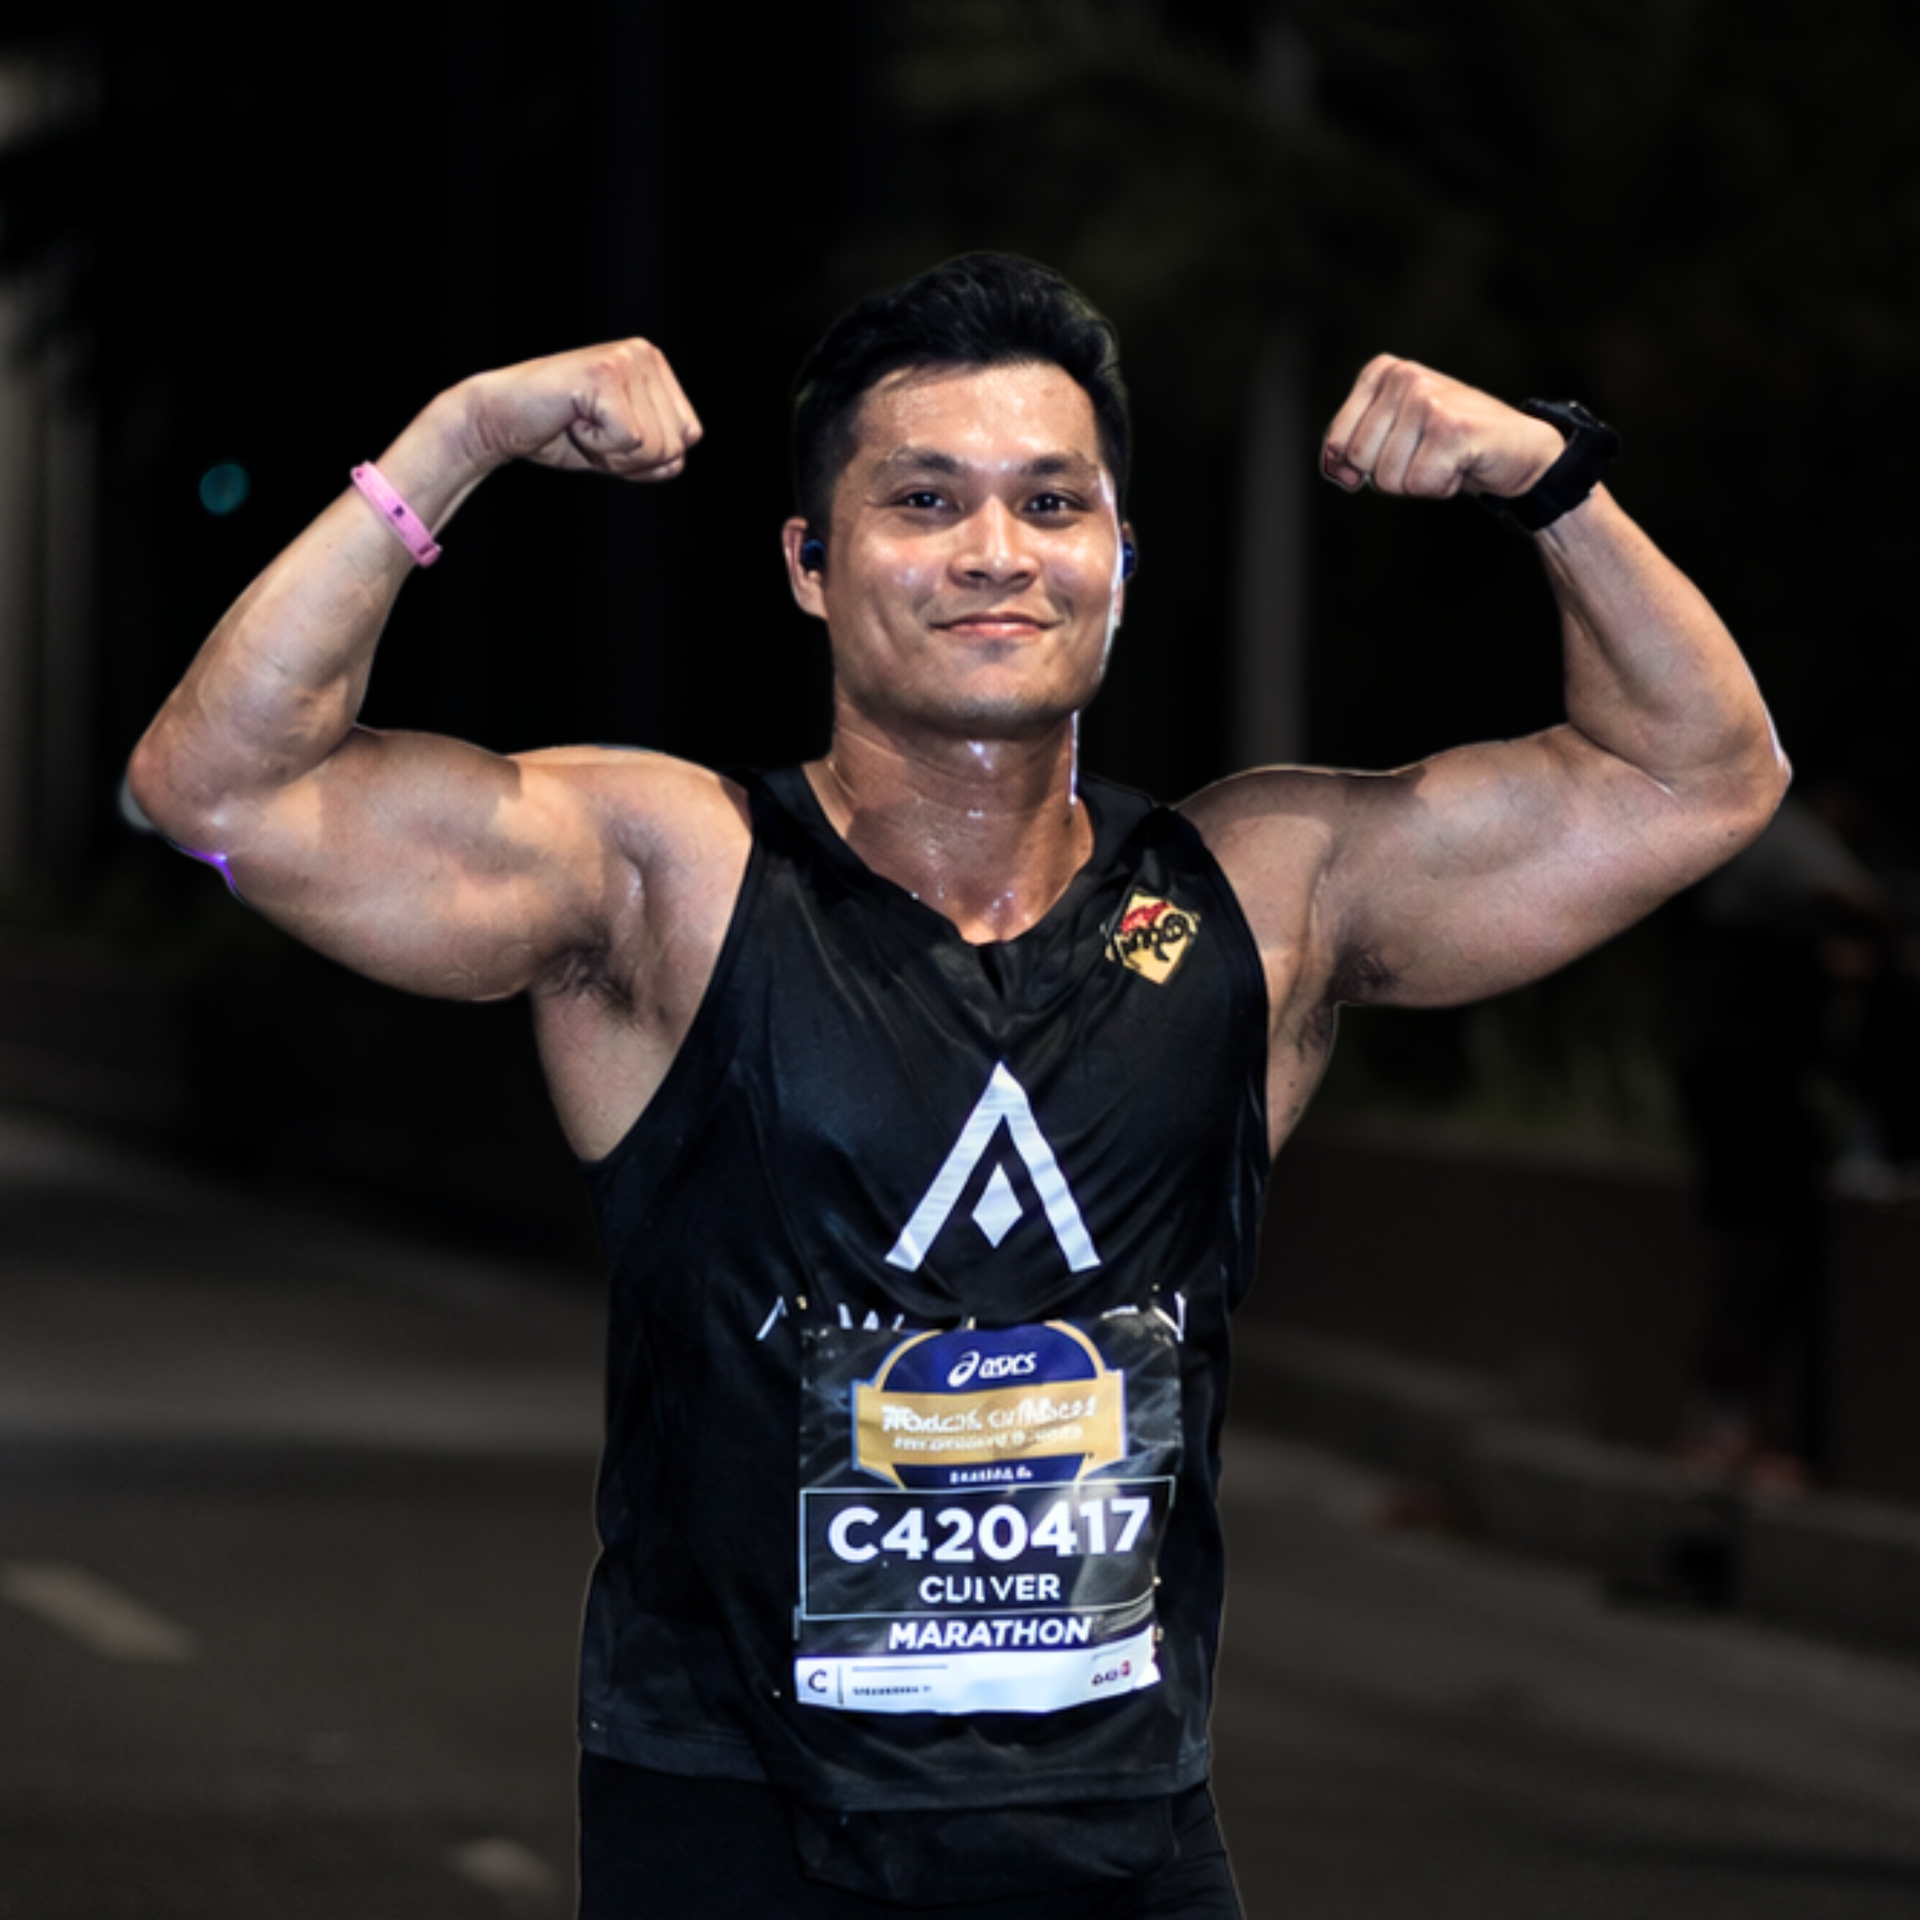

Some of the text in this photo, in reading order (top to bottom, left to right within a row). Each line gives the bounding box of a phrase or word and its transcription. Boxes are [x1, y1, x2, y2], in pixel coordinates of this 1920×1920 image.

[828, 1497, 1150, 1562] C420417
[889, 1616, 1092, 1650] MARATHON
[808, 1669, 828, 1693] C
